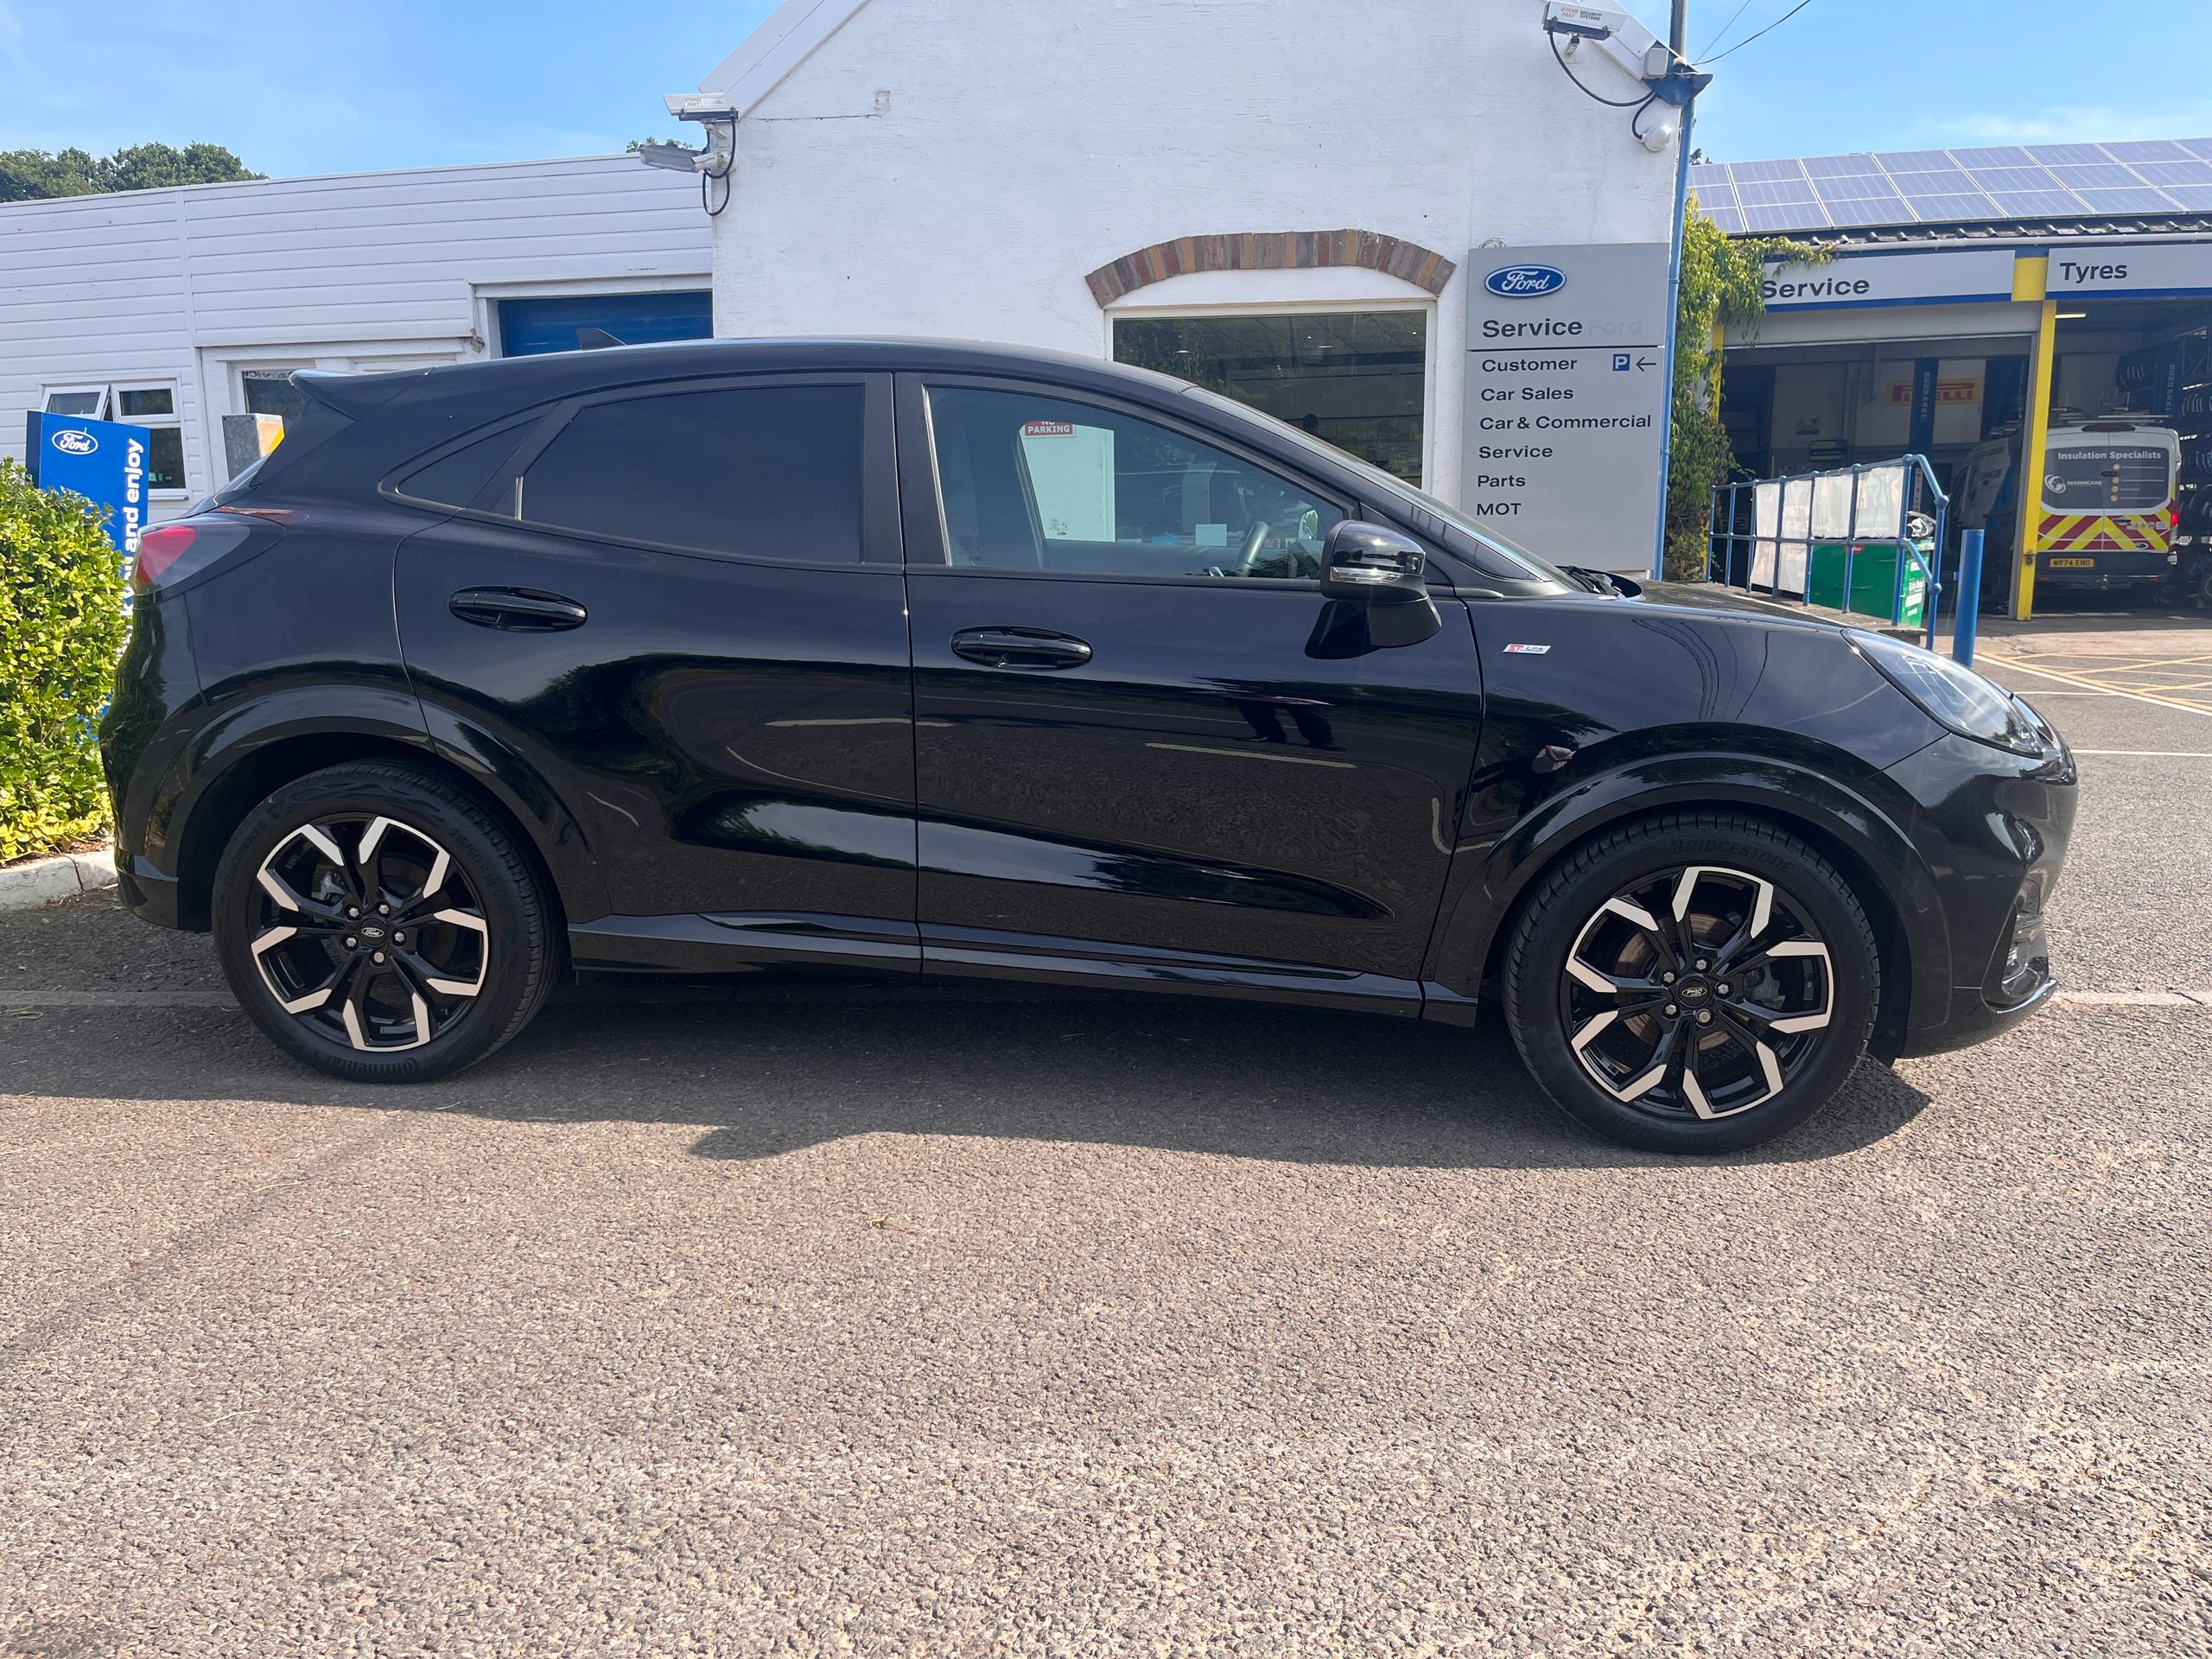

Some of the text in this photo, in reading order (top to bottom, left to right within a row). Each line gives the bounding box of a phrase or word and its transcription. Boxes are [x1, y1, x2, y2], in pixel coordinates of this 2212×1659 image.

[1501, 270, 1551, 291] Ford
[2059, 262, 2127, 283] Tyres
[1763, 277, 1870, 299] Service
[1482, 318, 1583, 338] Service
[1482, 359, 1578, 372] Customer
[1480, 387, 1574, 402] Car Sales
[1027, 425, 1071, 434] PARKING
[1479, 415, 1651, 429] Car & Commercial
[60, 433, 91, 453] Ford
[1478, 445, 1554, 459] Service
[2058, 451, 2162, 461] Insulation Specialists
[124, 438, 144, 503] enjoy
[1477, 474, 1526, 487] Parts
[1476, 503, 1522, 516] MOT
[124, 507, 138, 553] and
[1669, 839, 1795, 872] BRIDGESTONE
